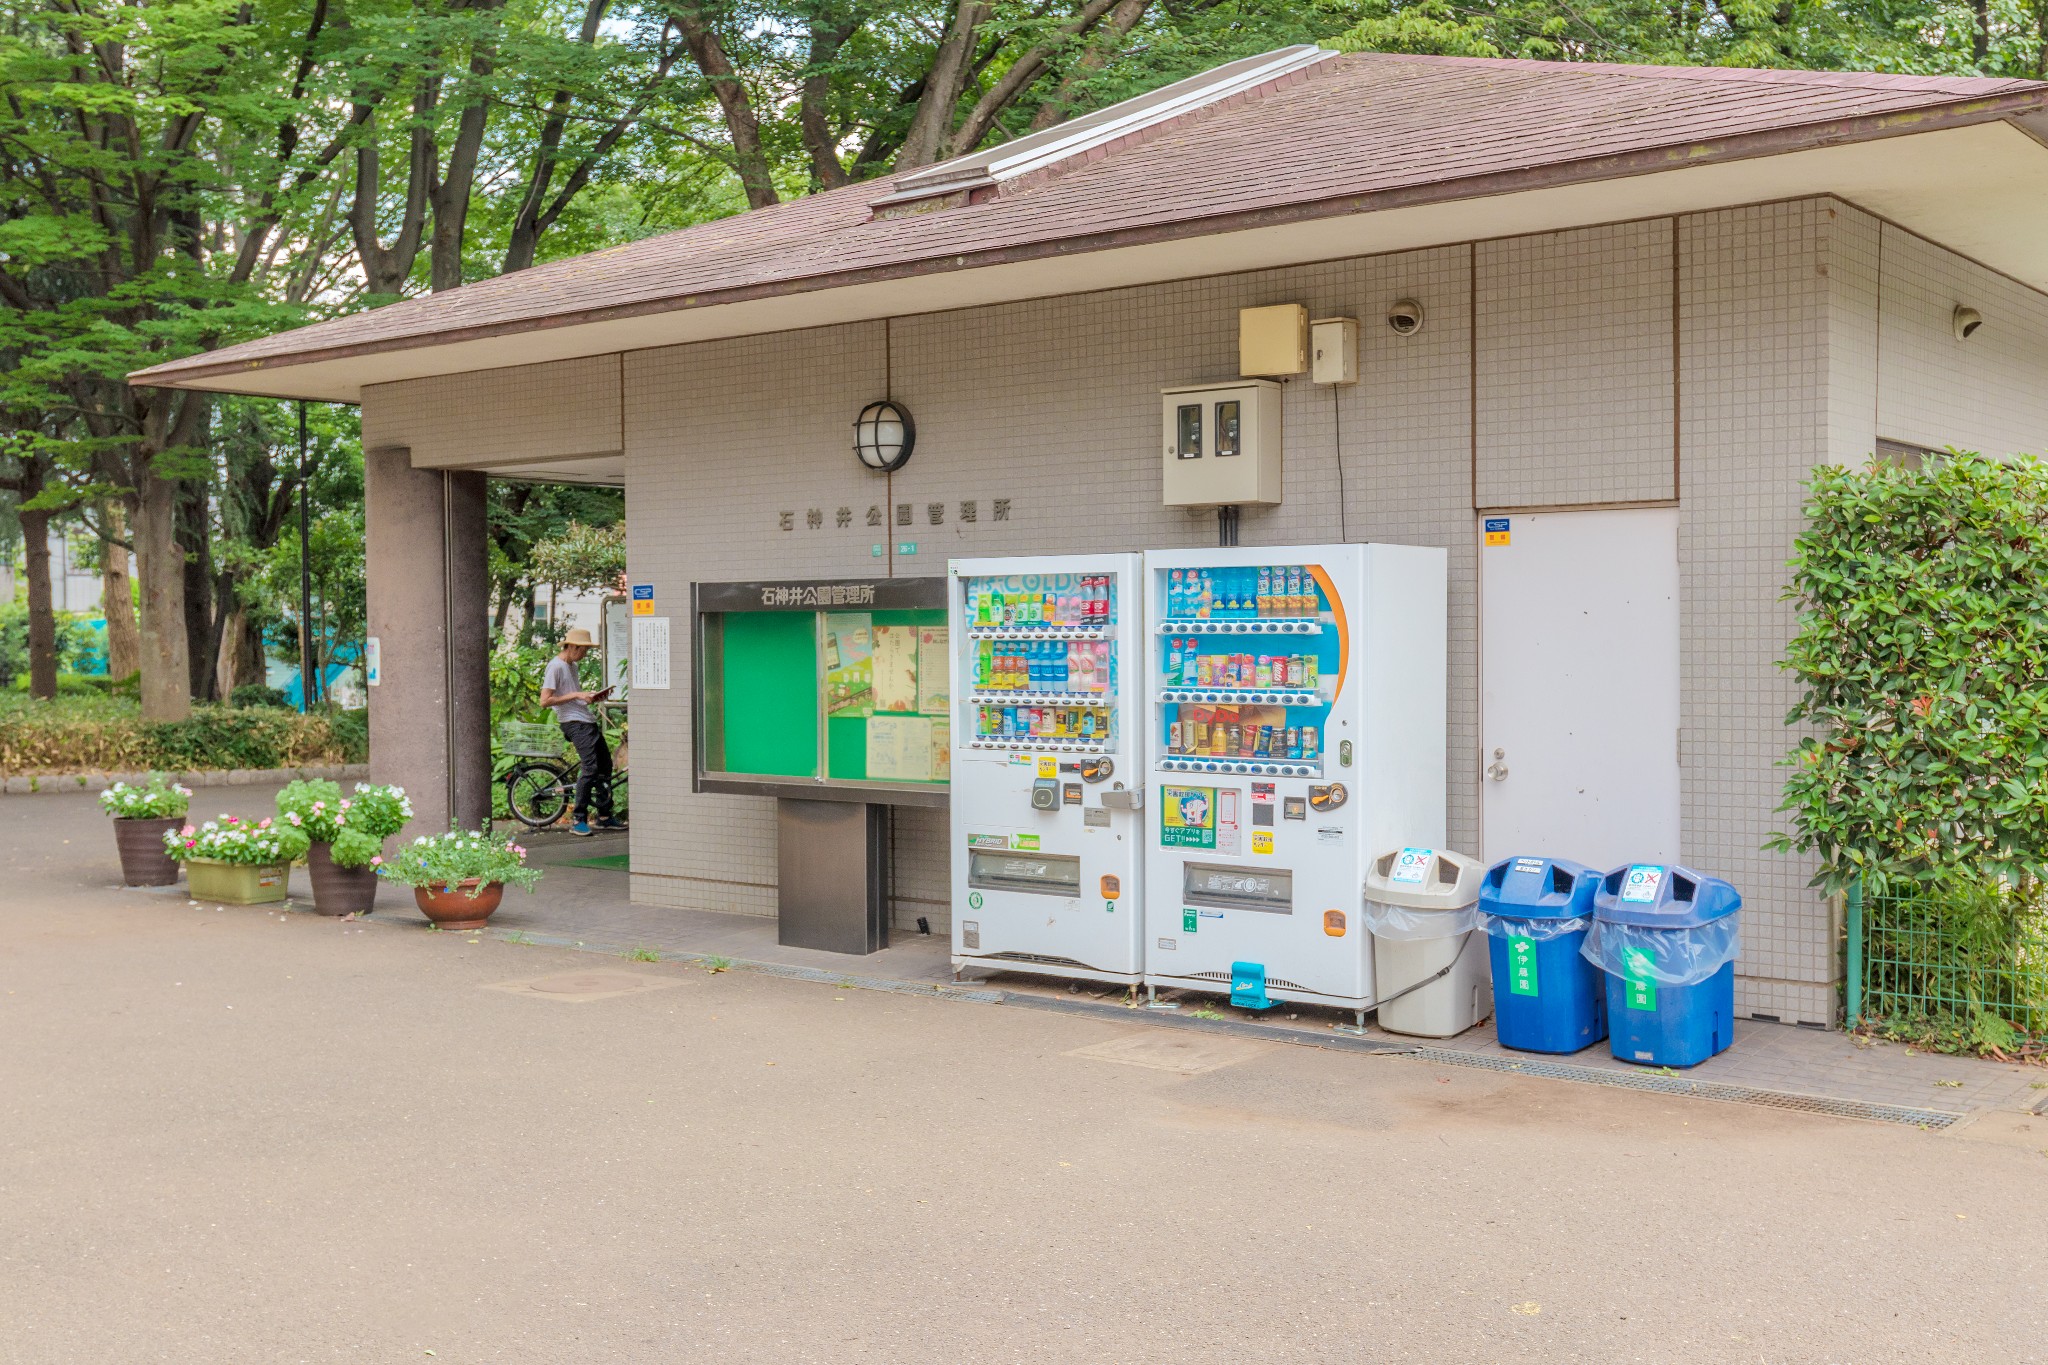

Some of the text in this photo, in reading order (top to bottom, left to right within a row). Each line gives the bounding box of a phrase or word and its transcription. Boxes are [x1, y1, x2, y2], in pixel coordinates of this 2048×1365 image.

[779, 498, 1011, 531] 石神井公園管理所
[1487, 521, 1508, 529] CSP
[634, 587, 652, 596] CSP
[761, 584, 875, 605] 石神井公園管理所
[1193, 709, 1240, 725] DyDo
